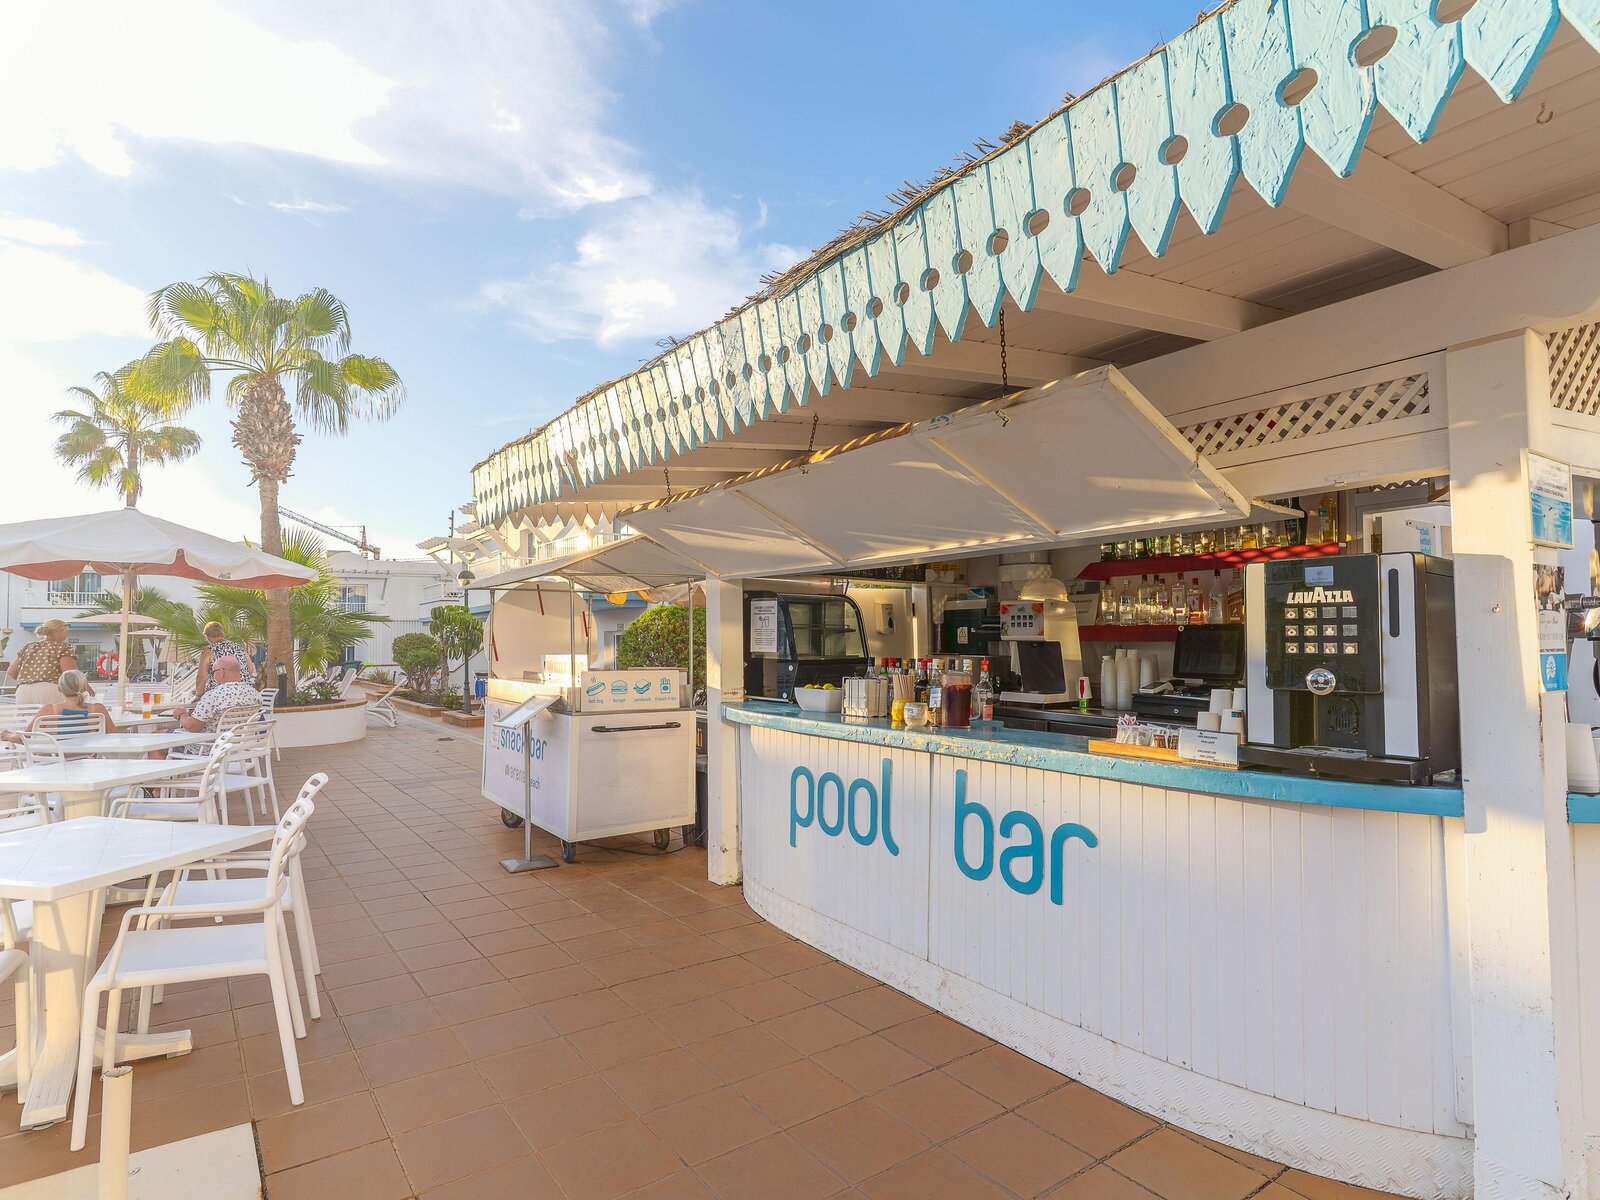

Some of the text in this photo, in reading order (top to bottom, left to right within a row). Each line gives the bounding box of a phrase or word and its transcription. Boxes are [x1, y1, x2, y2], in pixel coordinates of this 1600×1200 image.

[1286, 586, 1354, 605] LAVAZZA
[529, 729, 548, 761] bar
[789, 757, 1098, 906] pool bar
